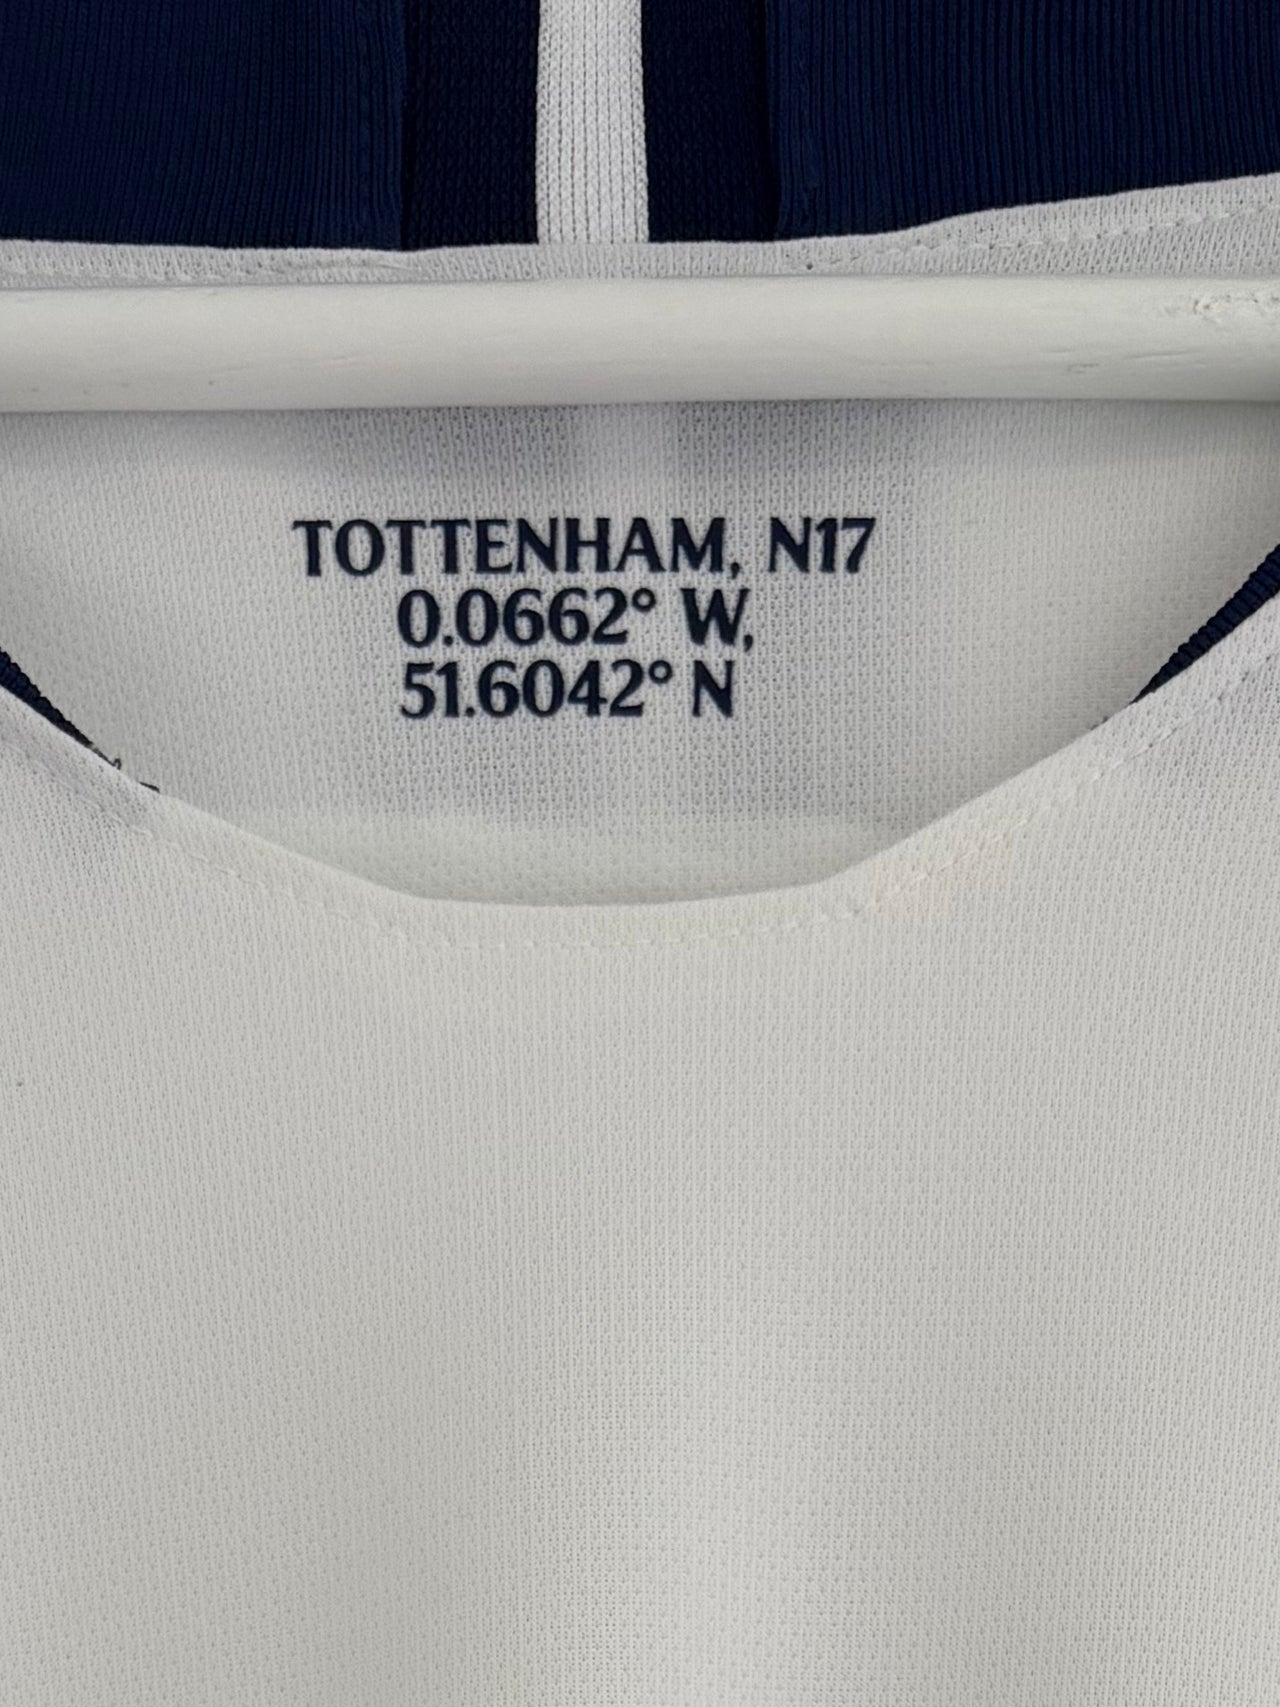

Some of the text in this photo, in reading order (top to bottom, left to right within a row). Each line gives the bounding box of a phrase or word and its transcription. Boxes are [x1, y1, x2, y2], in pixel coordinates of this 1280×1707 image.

[291, 514, 877, 580] TOTTENHAM, N17
[396, 585, 754, 653] 0.0662° W,
[400, 658, 736, 720] 51.6042° N
